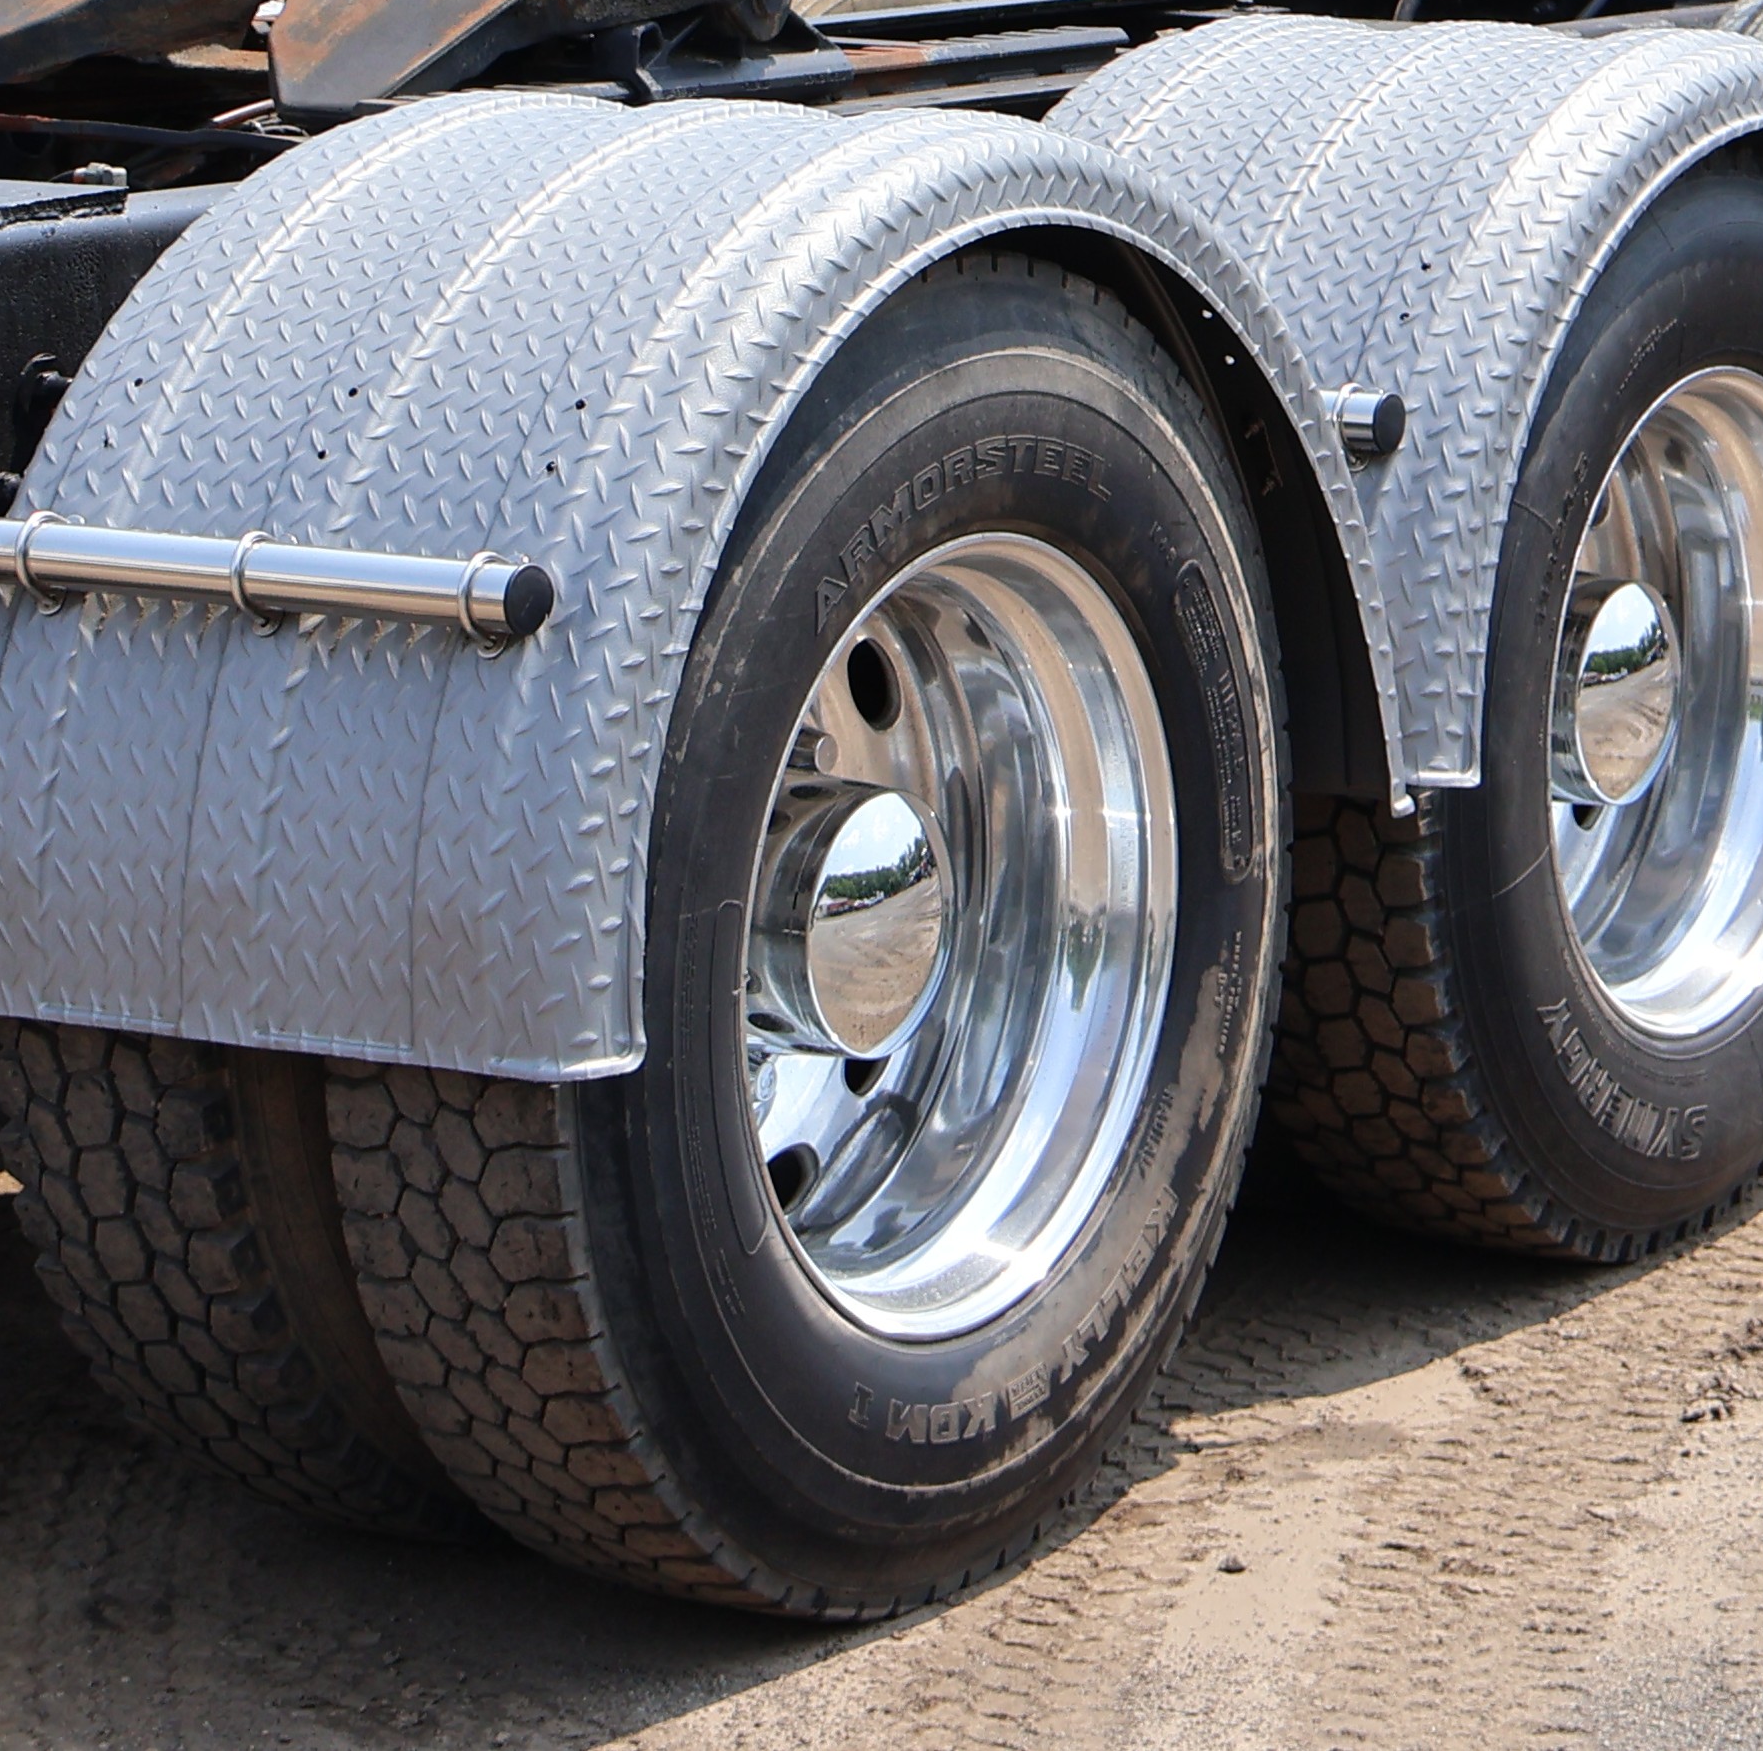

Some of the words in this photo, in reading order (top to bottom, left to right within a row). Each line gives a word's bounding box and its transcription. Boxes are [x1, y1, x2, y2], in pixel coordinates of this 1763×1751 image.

[813, 433, 1113, 637] ARMORSTEEL
[1535, 997, 1710, 1162] SYNERGY
[1058, 1185, 1180, 1385] KELLY
[884, 1390, 997, 1447] KDM
